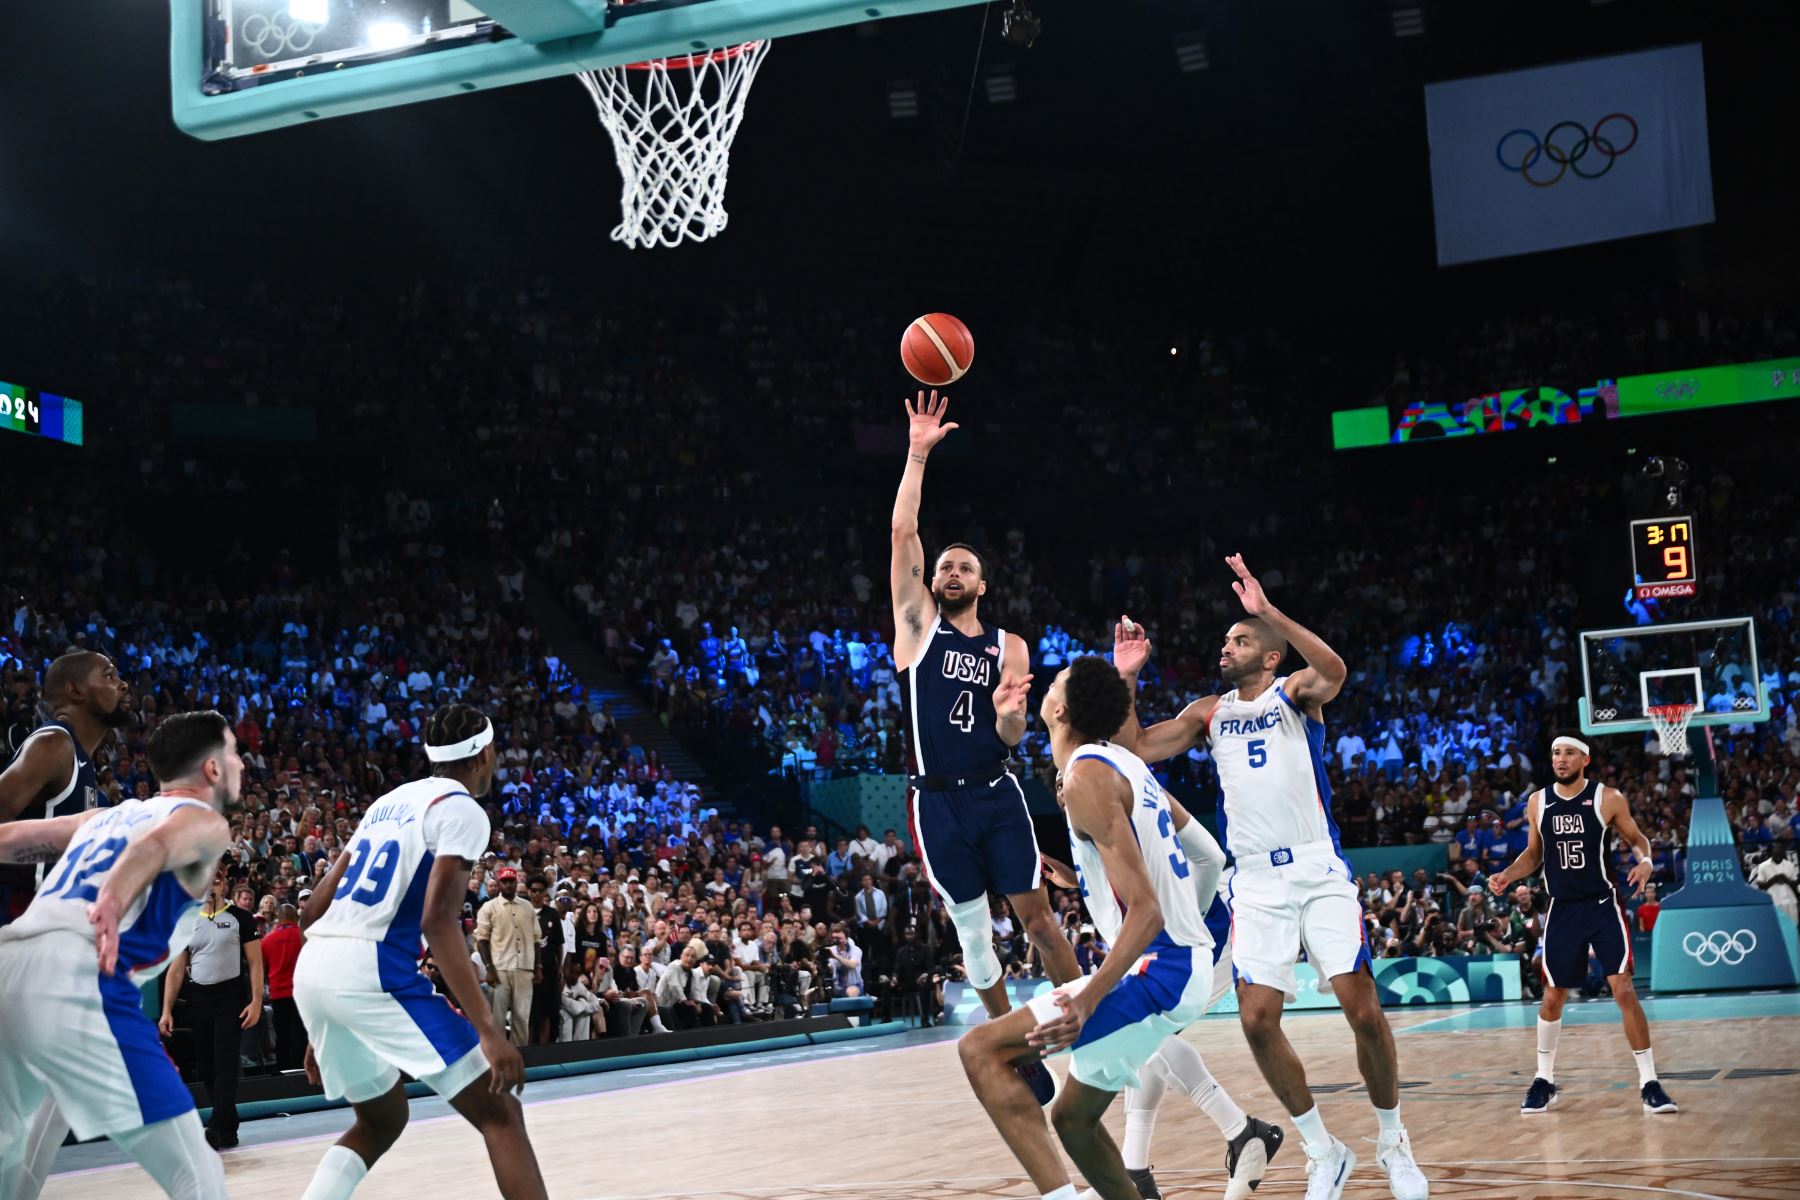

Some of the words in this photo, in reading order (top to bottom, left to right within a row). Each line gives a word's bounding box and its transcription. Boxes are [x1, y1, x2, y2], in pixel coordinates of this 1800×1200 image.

[1646, 523, 1688, 545] 3:17
[1663, 546, 1688, 580] 9
[1652, 584, 1694, 596] OMEGA
[942, 650, 991, 687] USA
[949, 690, 975, 733] 4
[1219, 706, 1283, 736] FRANCE
[1247, 739, 1268, 769] 5
[1552, 814, 1585, 835] USA
[41, 836, 129, 904] 12
[1556, 840, 1586, 870] 15
[1692, 859, 1733, 872] PARIS
[1693, 871, 1735, 884] 2024
